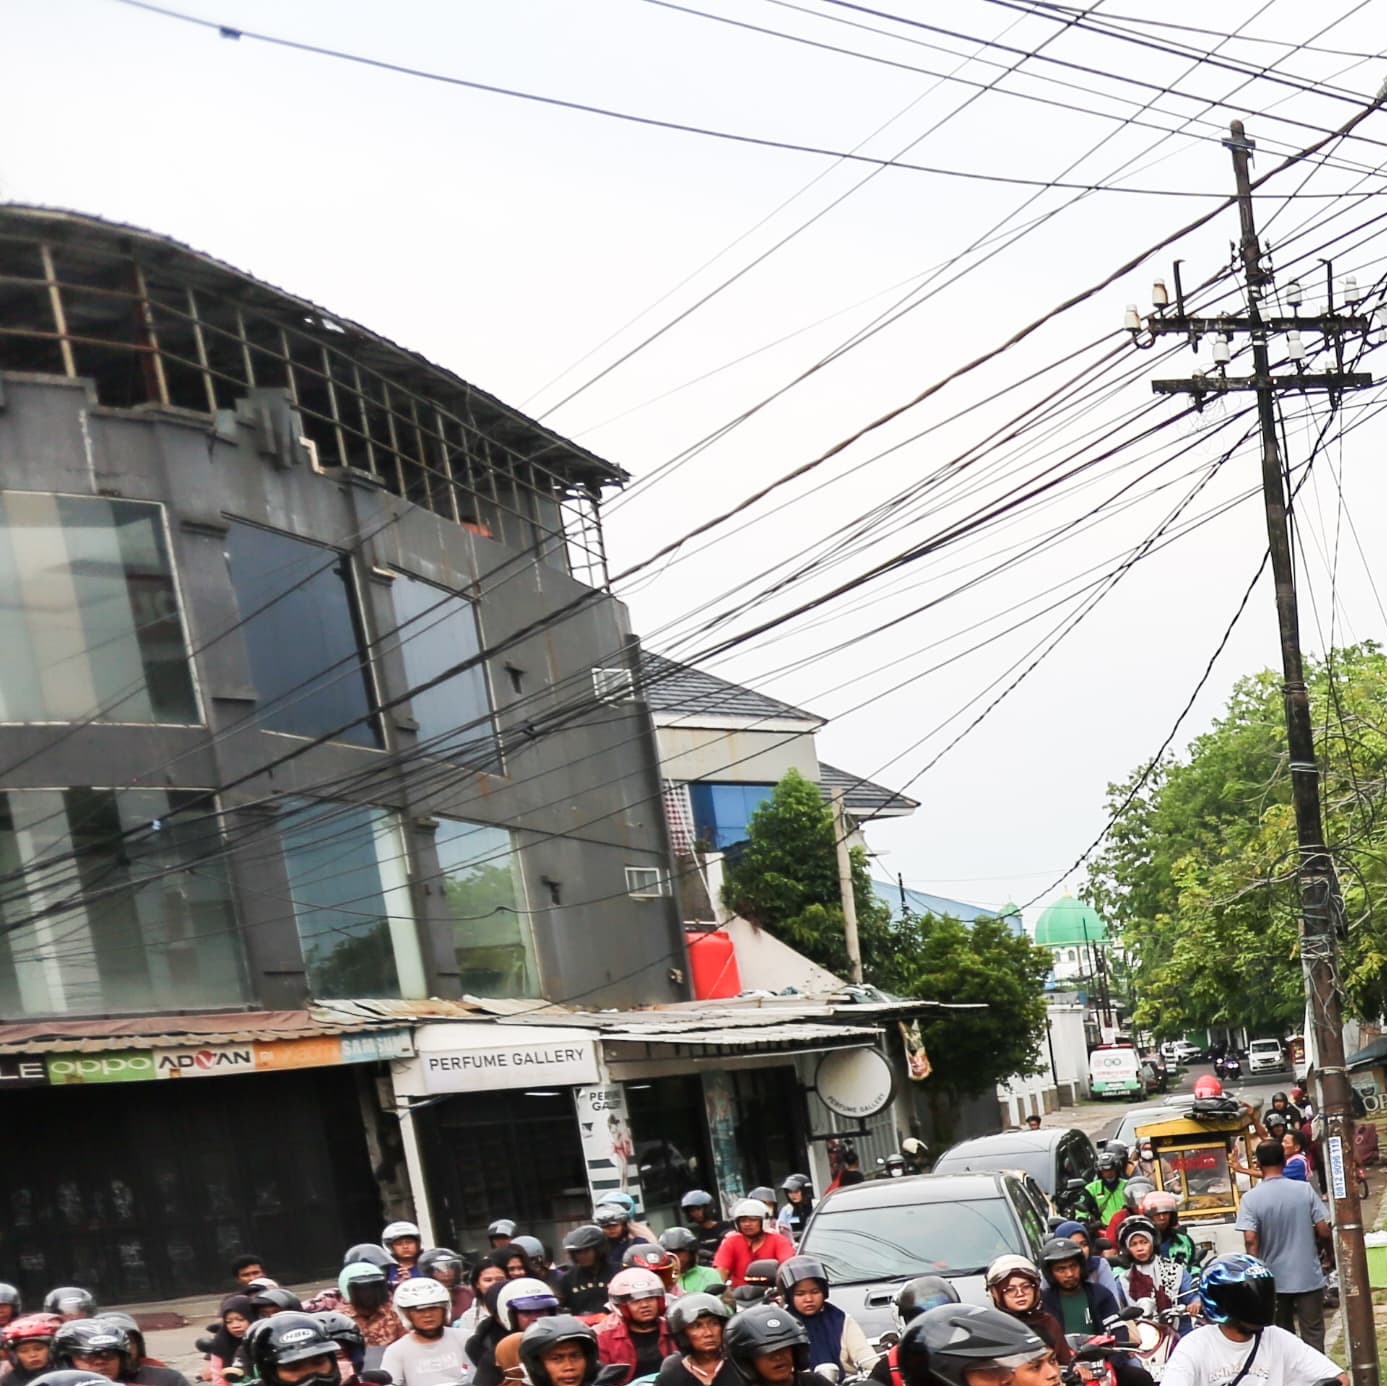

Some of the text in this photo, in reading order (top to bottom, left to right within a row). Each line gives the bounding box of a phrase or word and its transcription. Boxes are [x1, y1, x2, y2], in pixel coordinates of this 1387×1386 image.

[50, 1057, 152, 1076] oppo
[159, 1049, 251, 1070] ADVAN
[429, 1048, 585, 1072] PERFUME GALLERY
